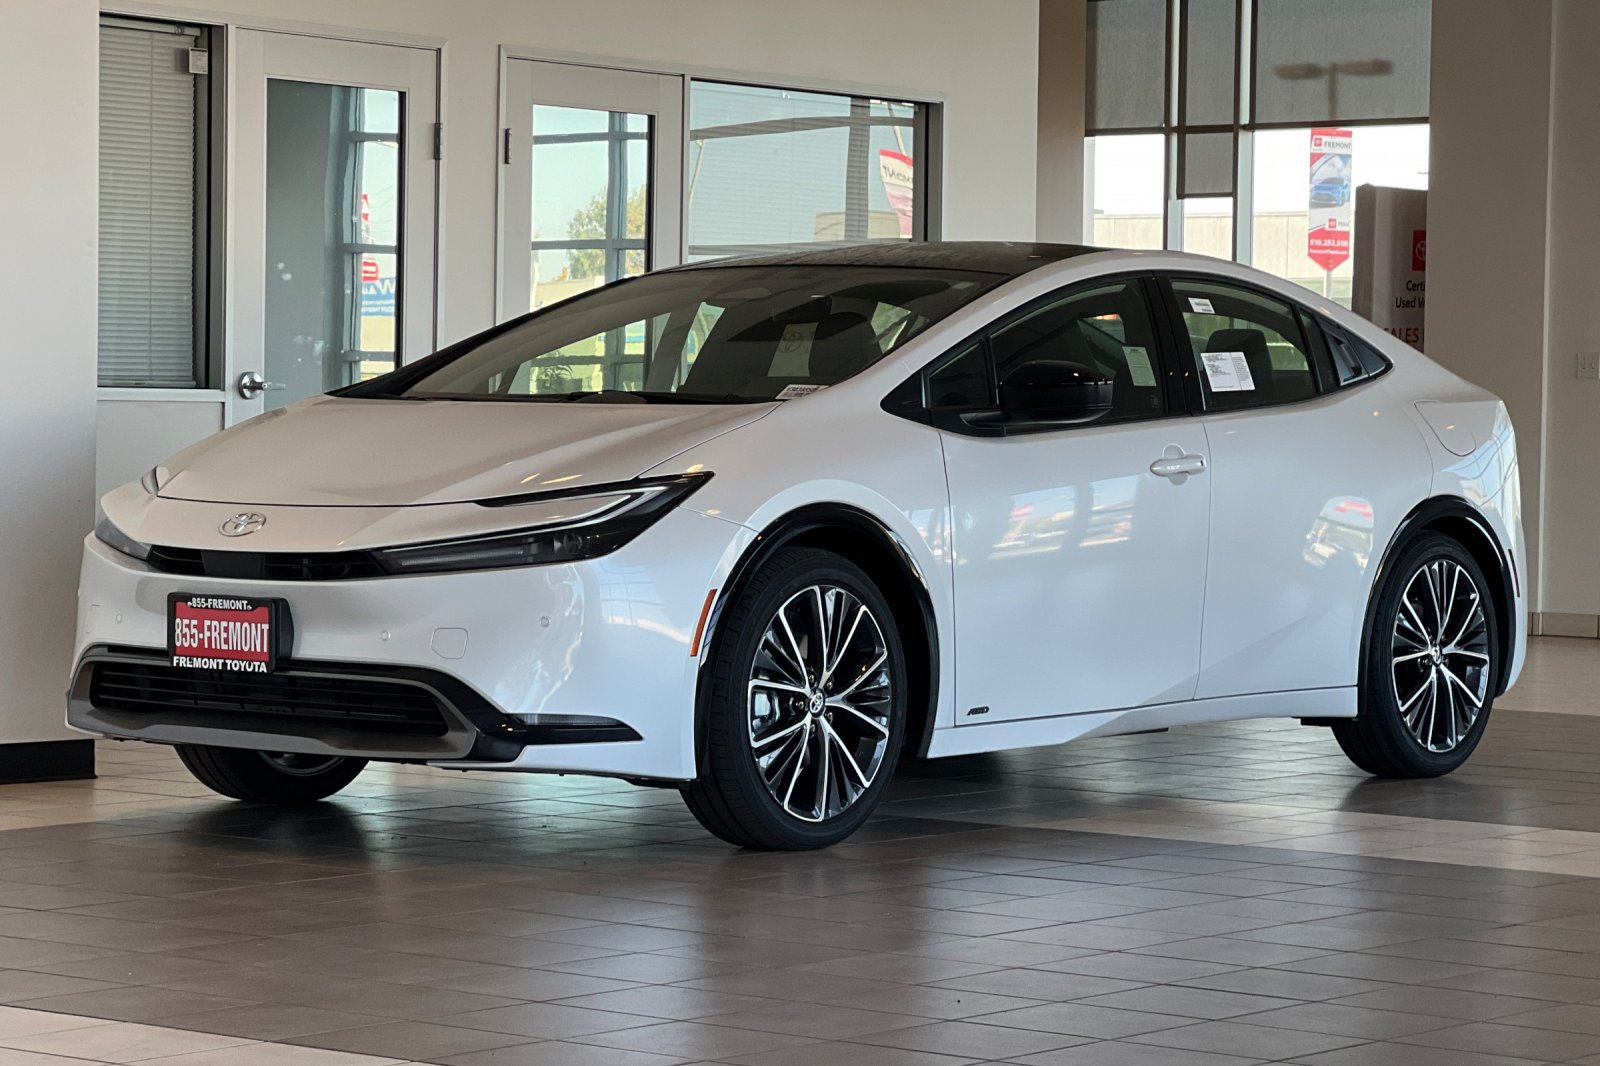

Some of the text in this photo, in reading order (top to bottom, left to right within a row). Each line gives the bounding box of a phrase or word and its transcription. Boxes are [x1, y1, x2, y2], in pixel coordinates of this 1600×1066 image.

[1324, 141, 1351, 149] FREMONT
[1395, 296, 1425, 308] Used V
[1384, 327, 1420, 343] ALES
[191, 597, 248, 610] 855-FREMONT
[174, 618, 269, 652] 855-FREMONT
[173, 656, 267, 673] FREMONT TOYOTA
